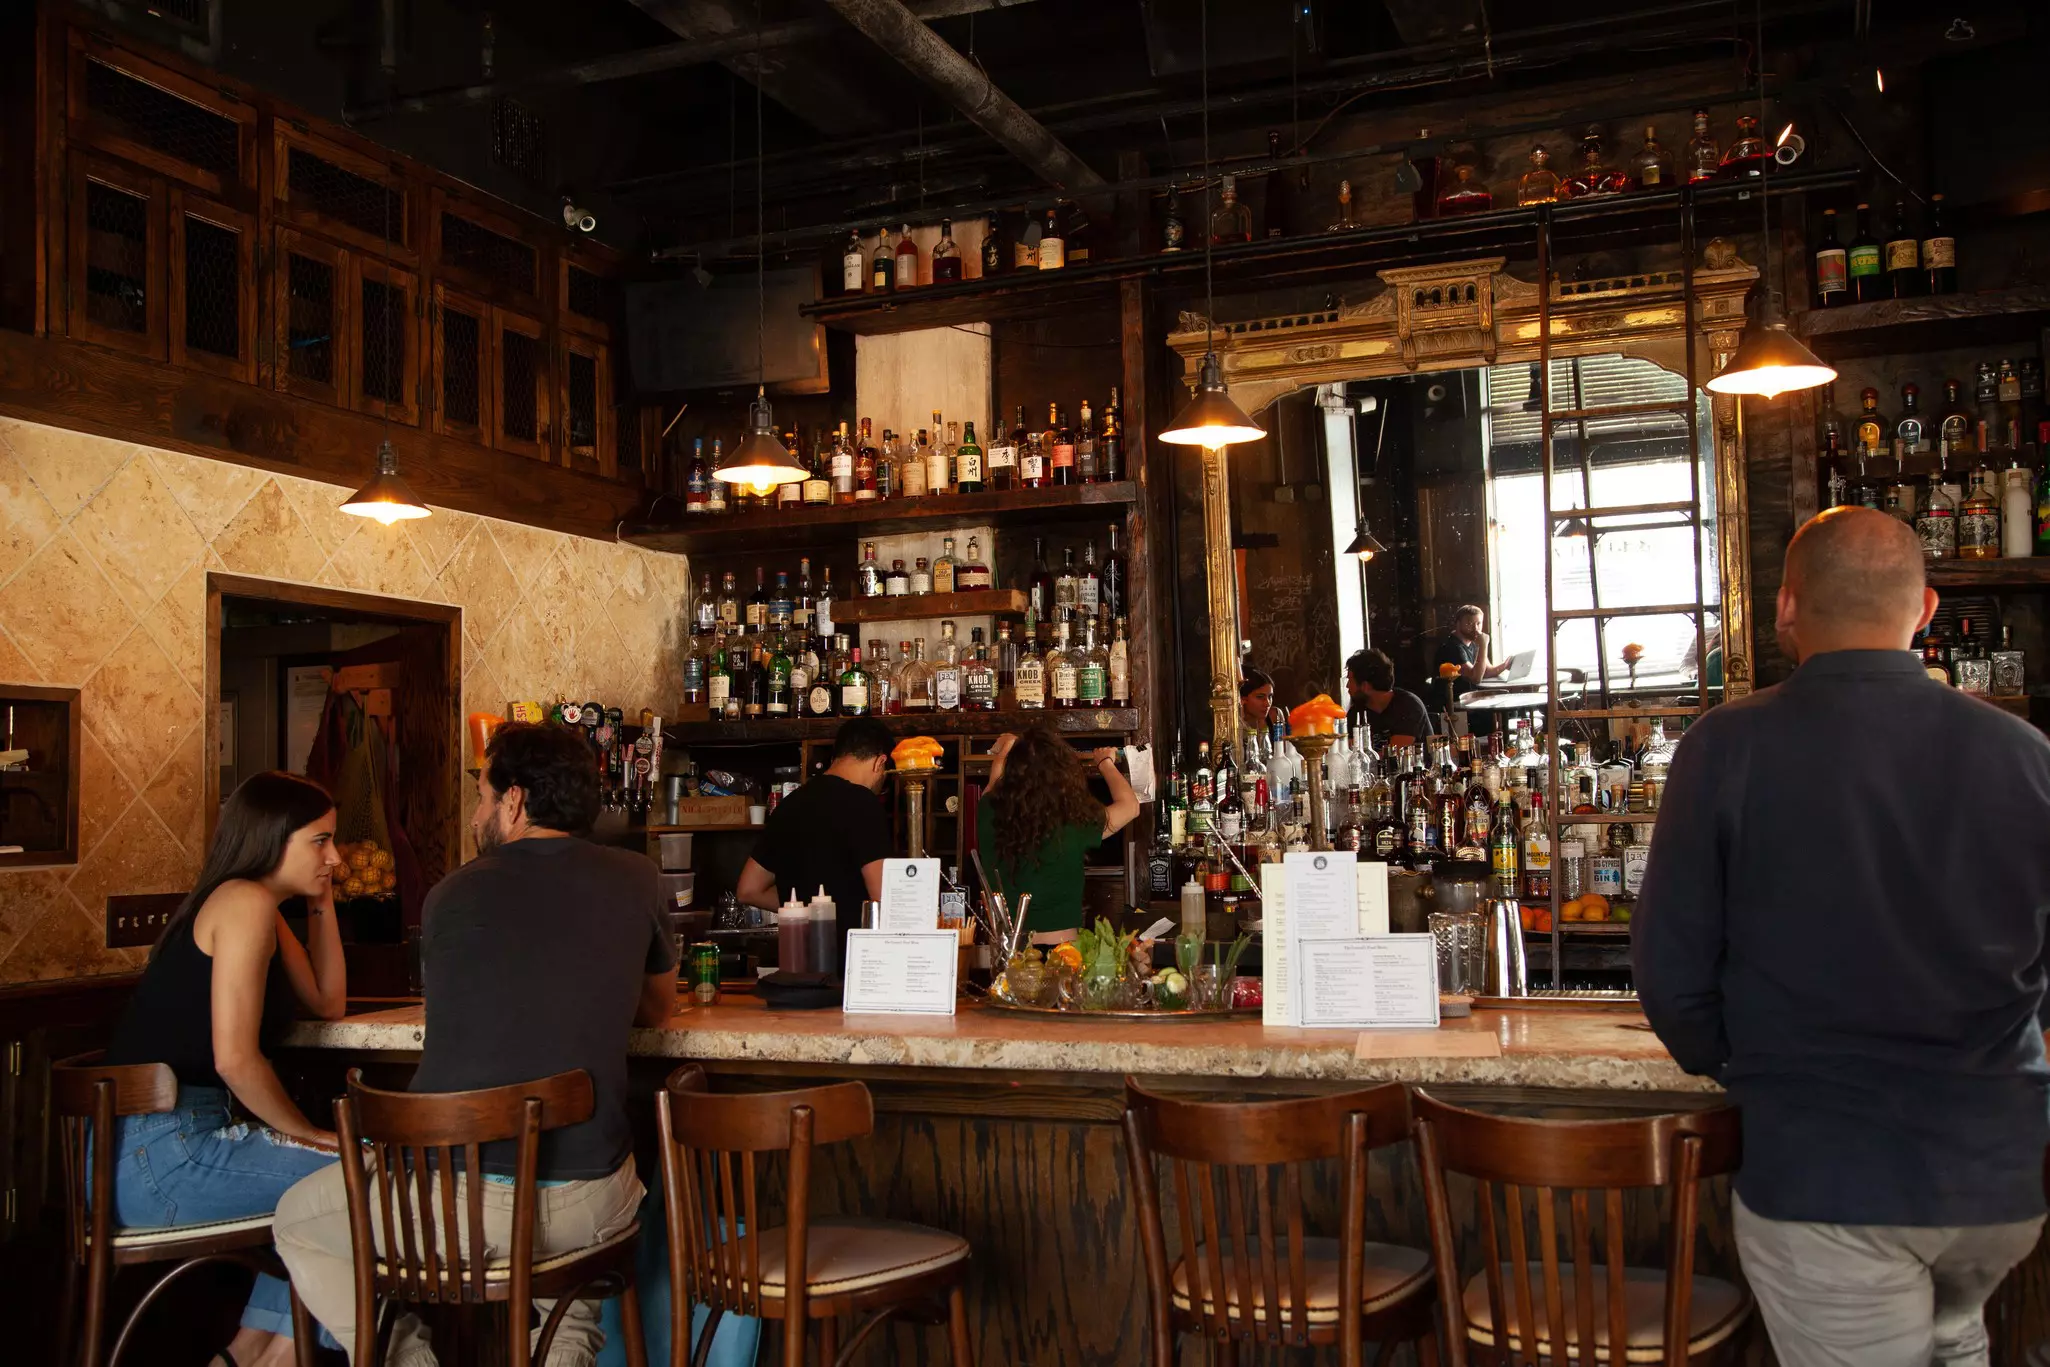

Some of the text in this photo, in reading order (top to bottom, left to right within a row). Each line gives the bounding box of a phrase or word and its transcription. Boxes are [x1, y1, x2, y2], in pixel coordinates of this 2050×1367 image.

[1907, 422, 1913, 430] 7
[1953, 418, 1959, 426] 7
[968, 457, 977, 477] 白州
[939, 672, 956, 681] FEW
[1017, 670, 1038, 679] KNOB
[968, 675, 988, 684] KNOB
[1594, 874, 1610, 882] GIN
